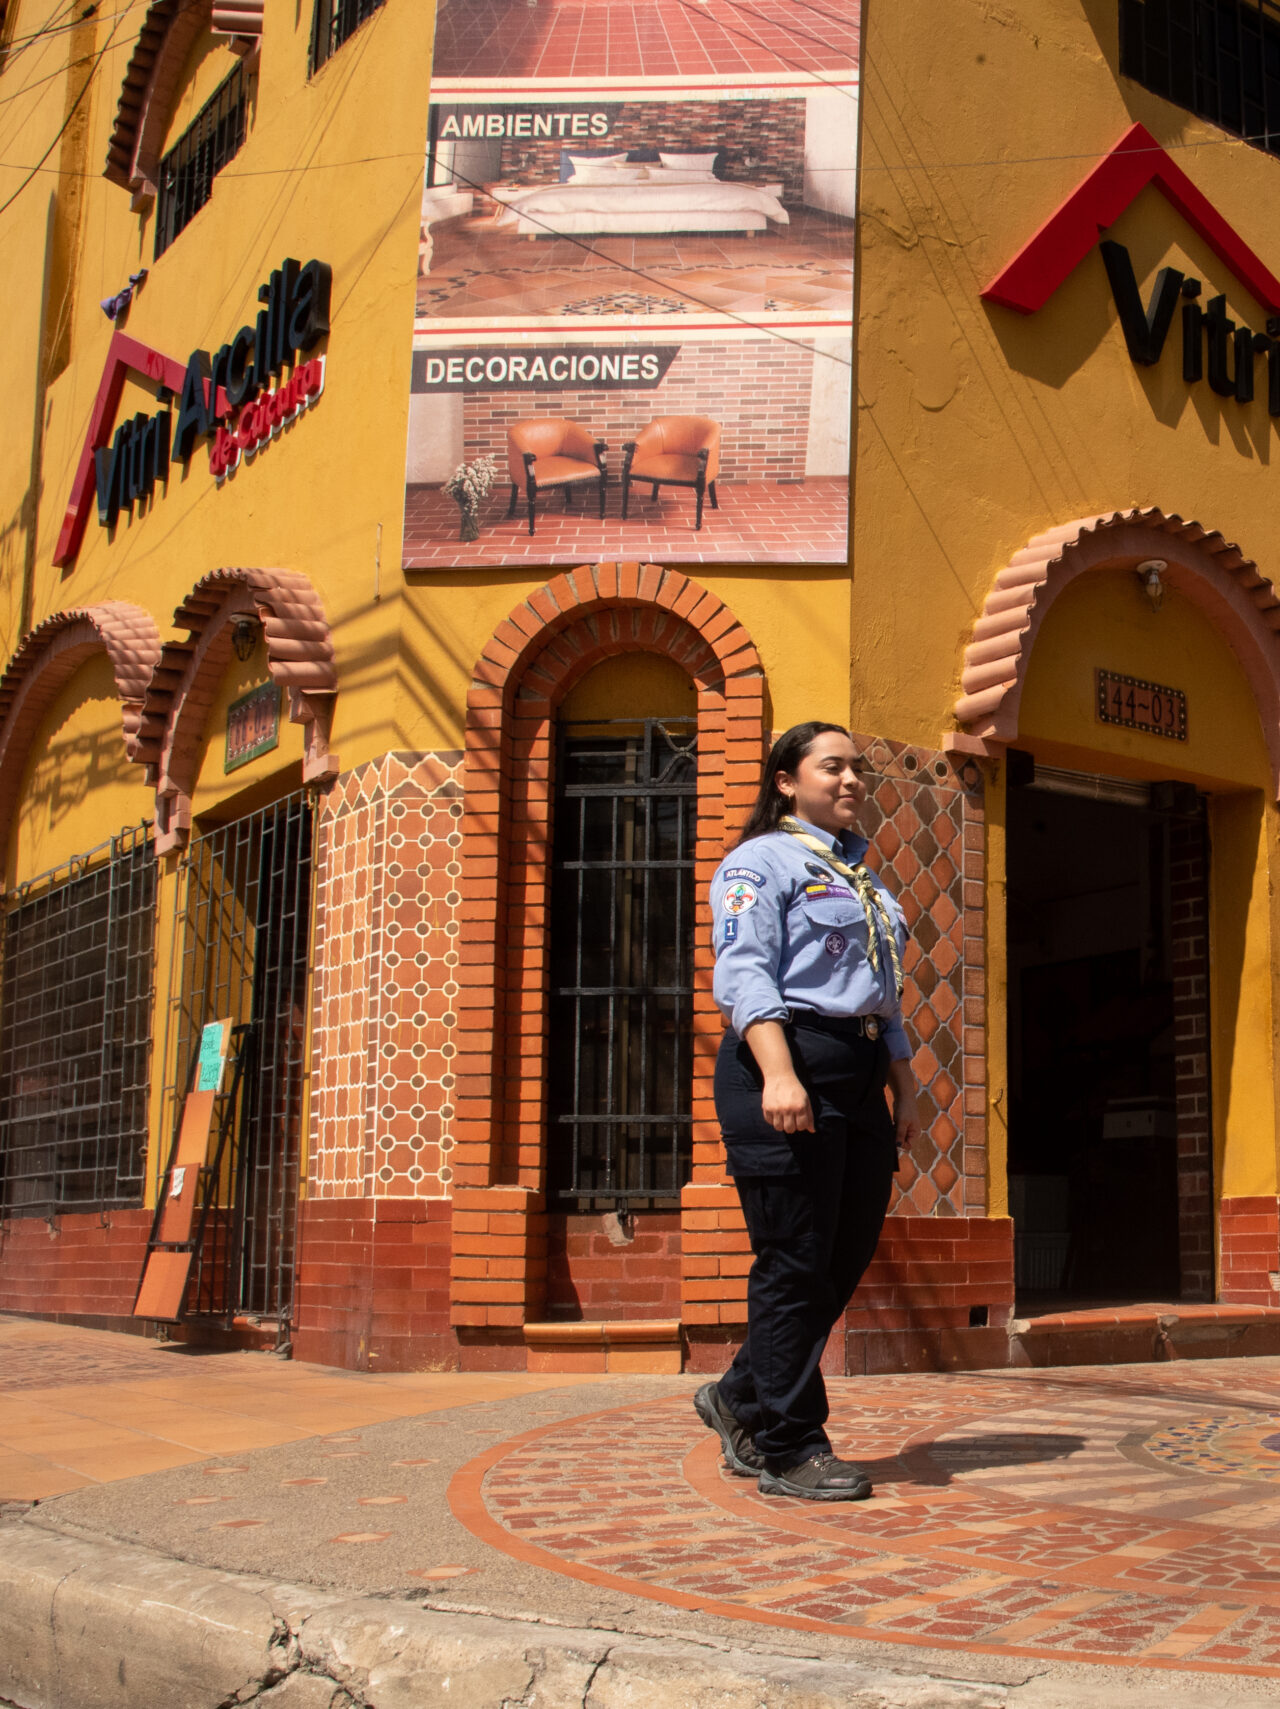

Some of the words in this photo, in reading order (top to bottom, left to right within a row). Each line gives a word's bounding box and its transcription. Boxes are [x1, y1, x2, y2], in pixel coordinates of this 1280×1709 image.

[440, 113, 609, 137] AMBIENTES
[425, 354, 660, 384] DECORACIONES
[95, 385, 173, 528] Vitri
[172, 257, 333, 463] Arcilla
[209, 427, 241, 483] de
[726, 921, 735, 936] 1
